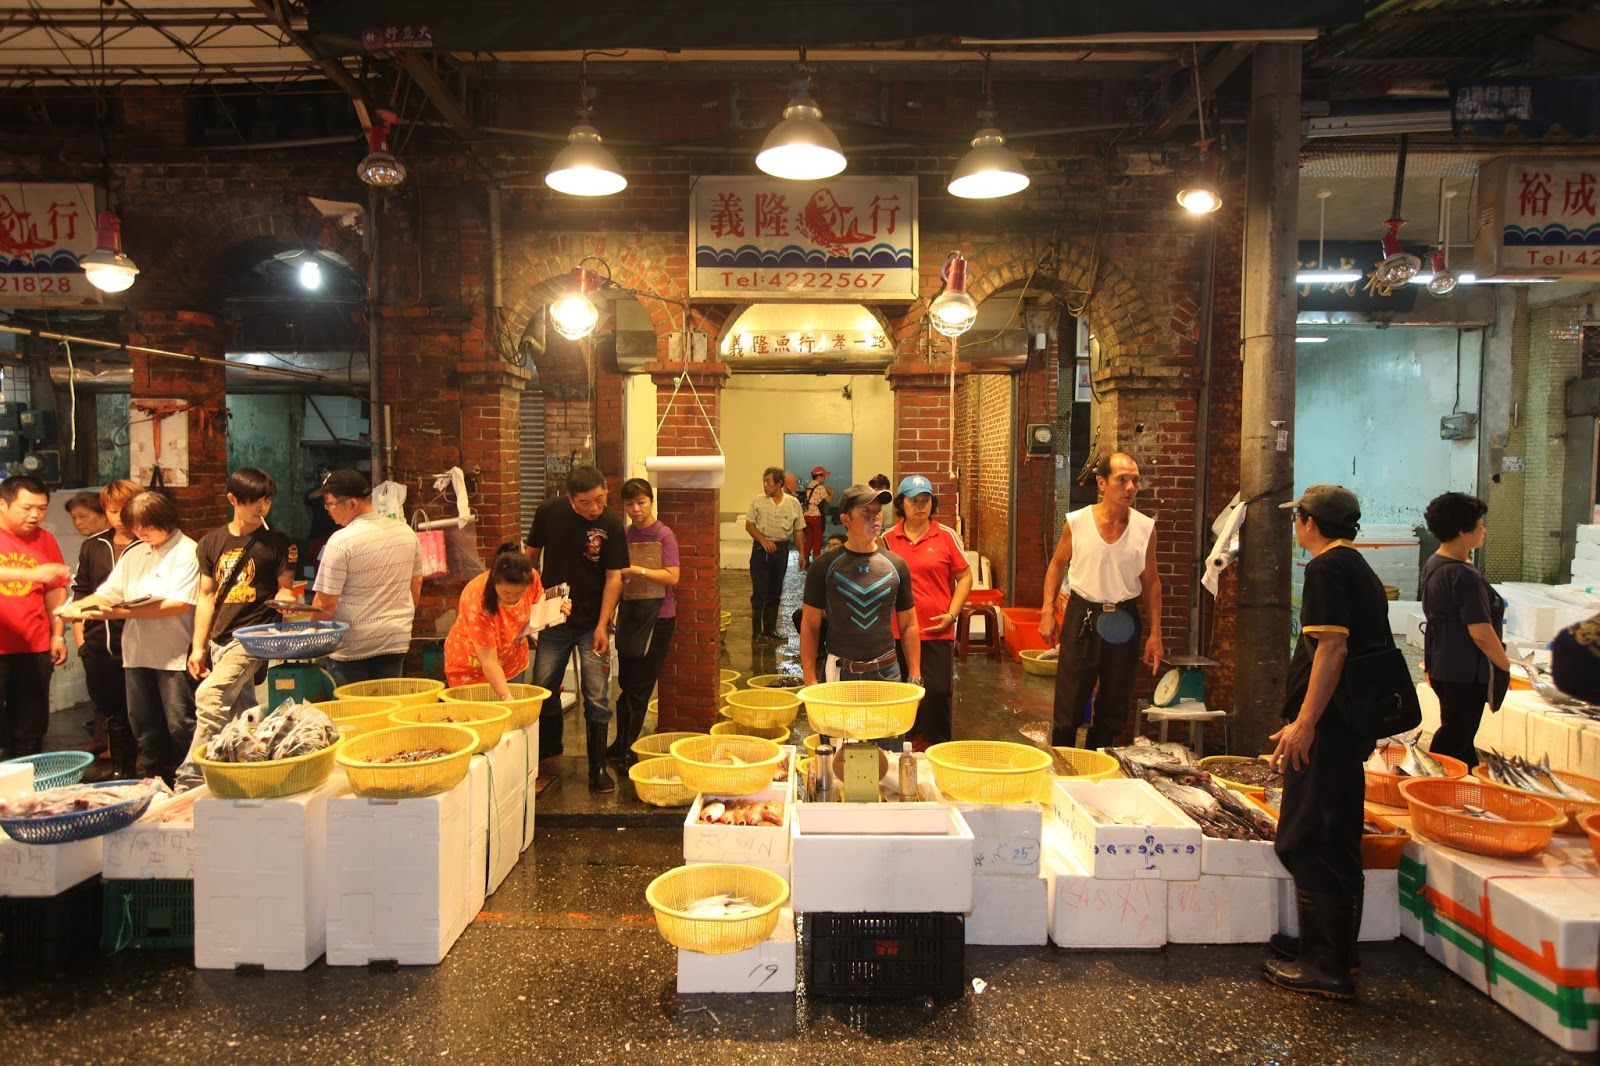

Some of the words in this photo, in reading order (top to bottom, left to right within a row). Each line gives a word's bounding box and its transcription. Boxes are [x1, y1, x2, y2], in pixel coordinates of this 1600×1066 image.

[47, 202, 78, 240] 行
[720, 271, 886, 289] Tel:4222567
[748, 964, 778, 988] 19
